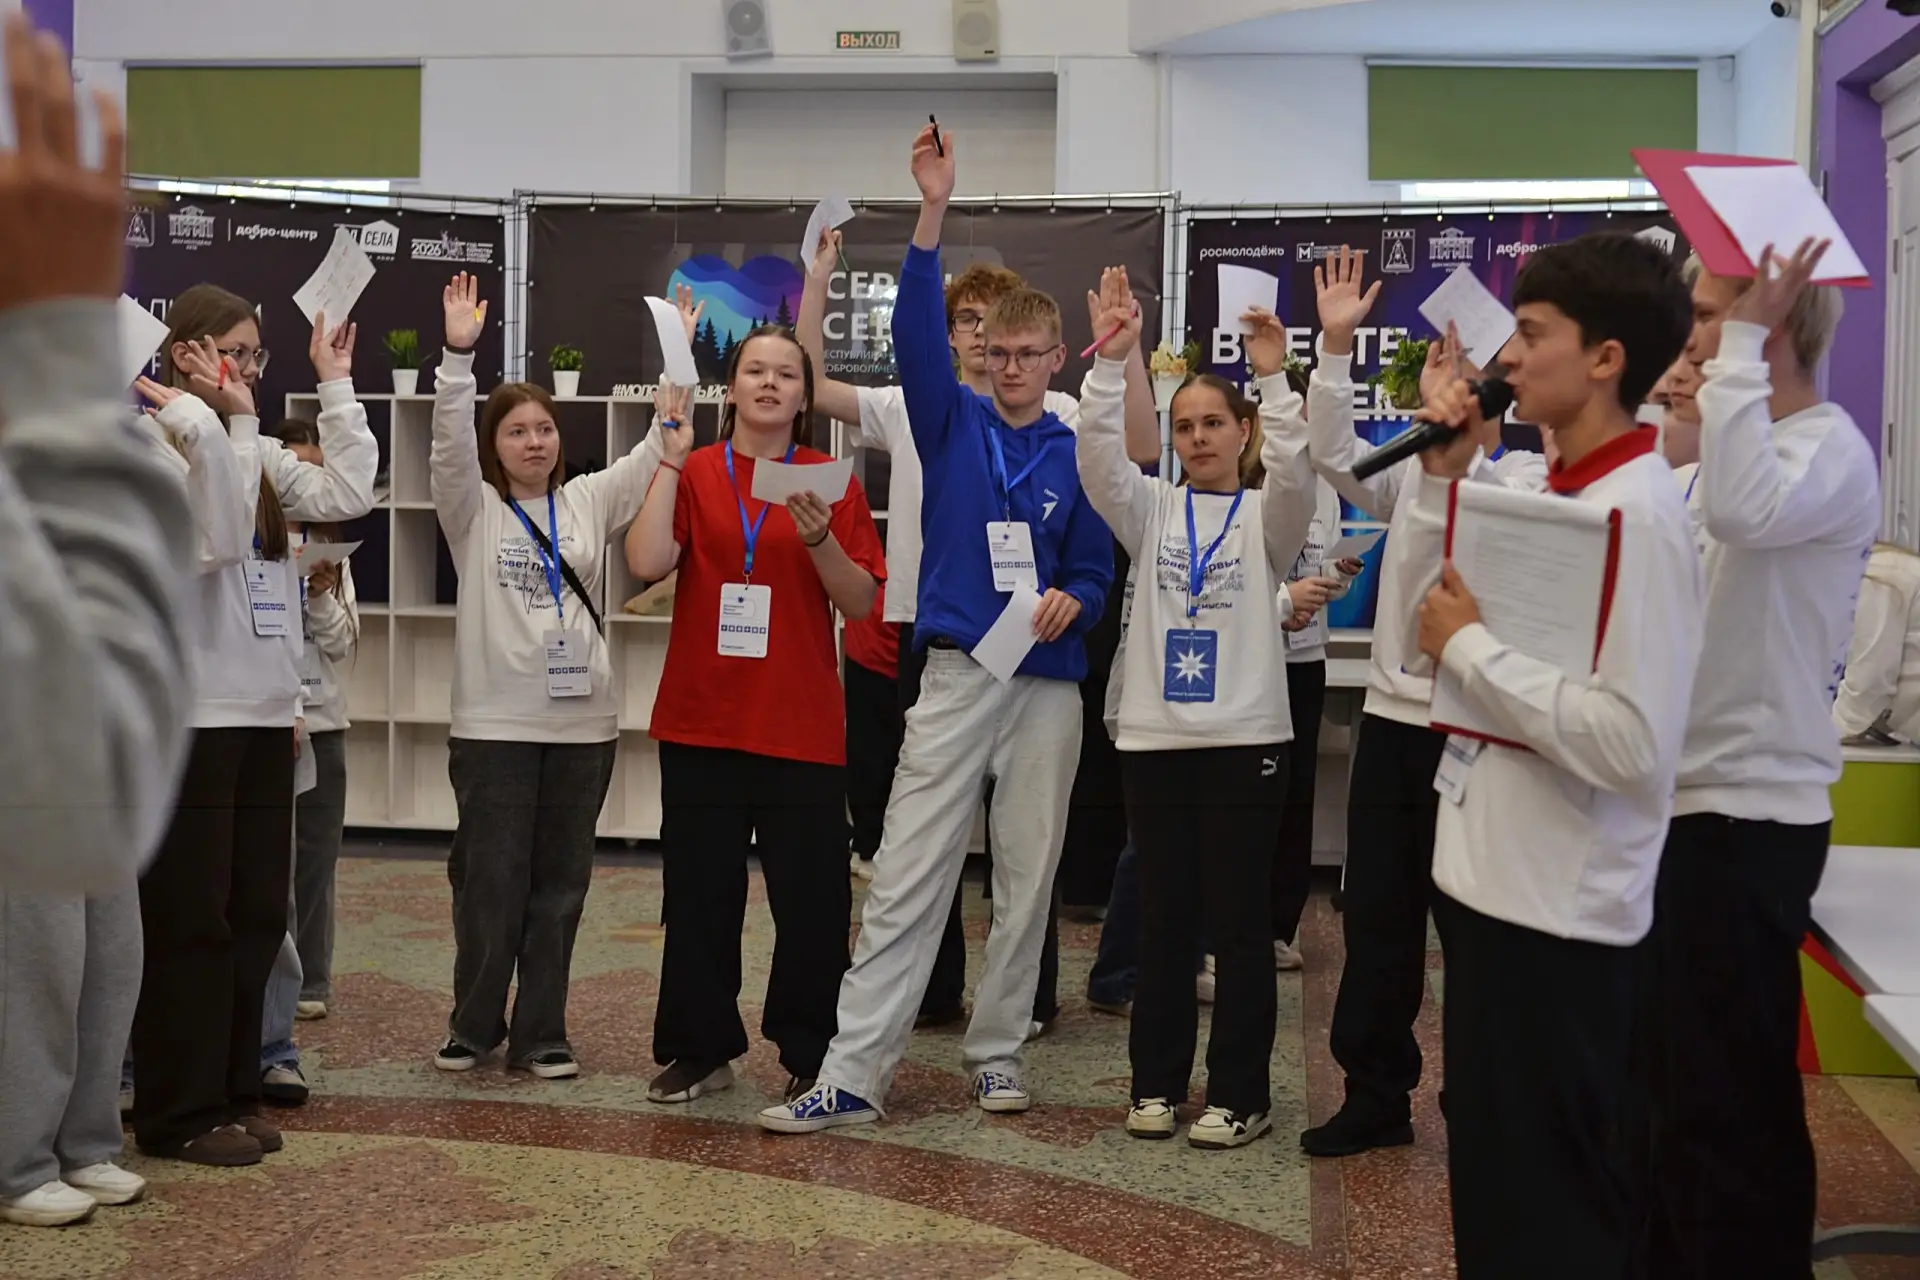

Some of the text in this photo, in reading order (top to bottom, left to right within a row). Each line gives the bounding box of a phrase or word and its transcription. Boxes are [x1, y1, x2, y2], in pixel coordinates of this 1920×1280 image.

[840, 33, 898, 48] ВЫХОД
[364, 230, 394, 247] СЕЛА
[411, 242, 441, 256] 2026
[1200, 246, 1285, 261] росмолодёжь
